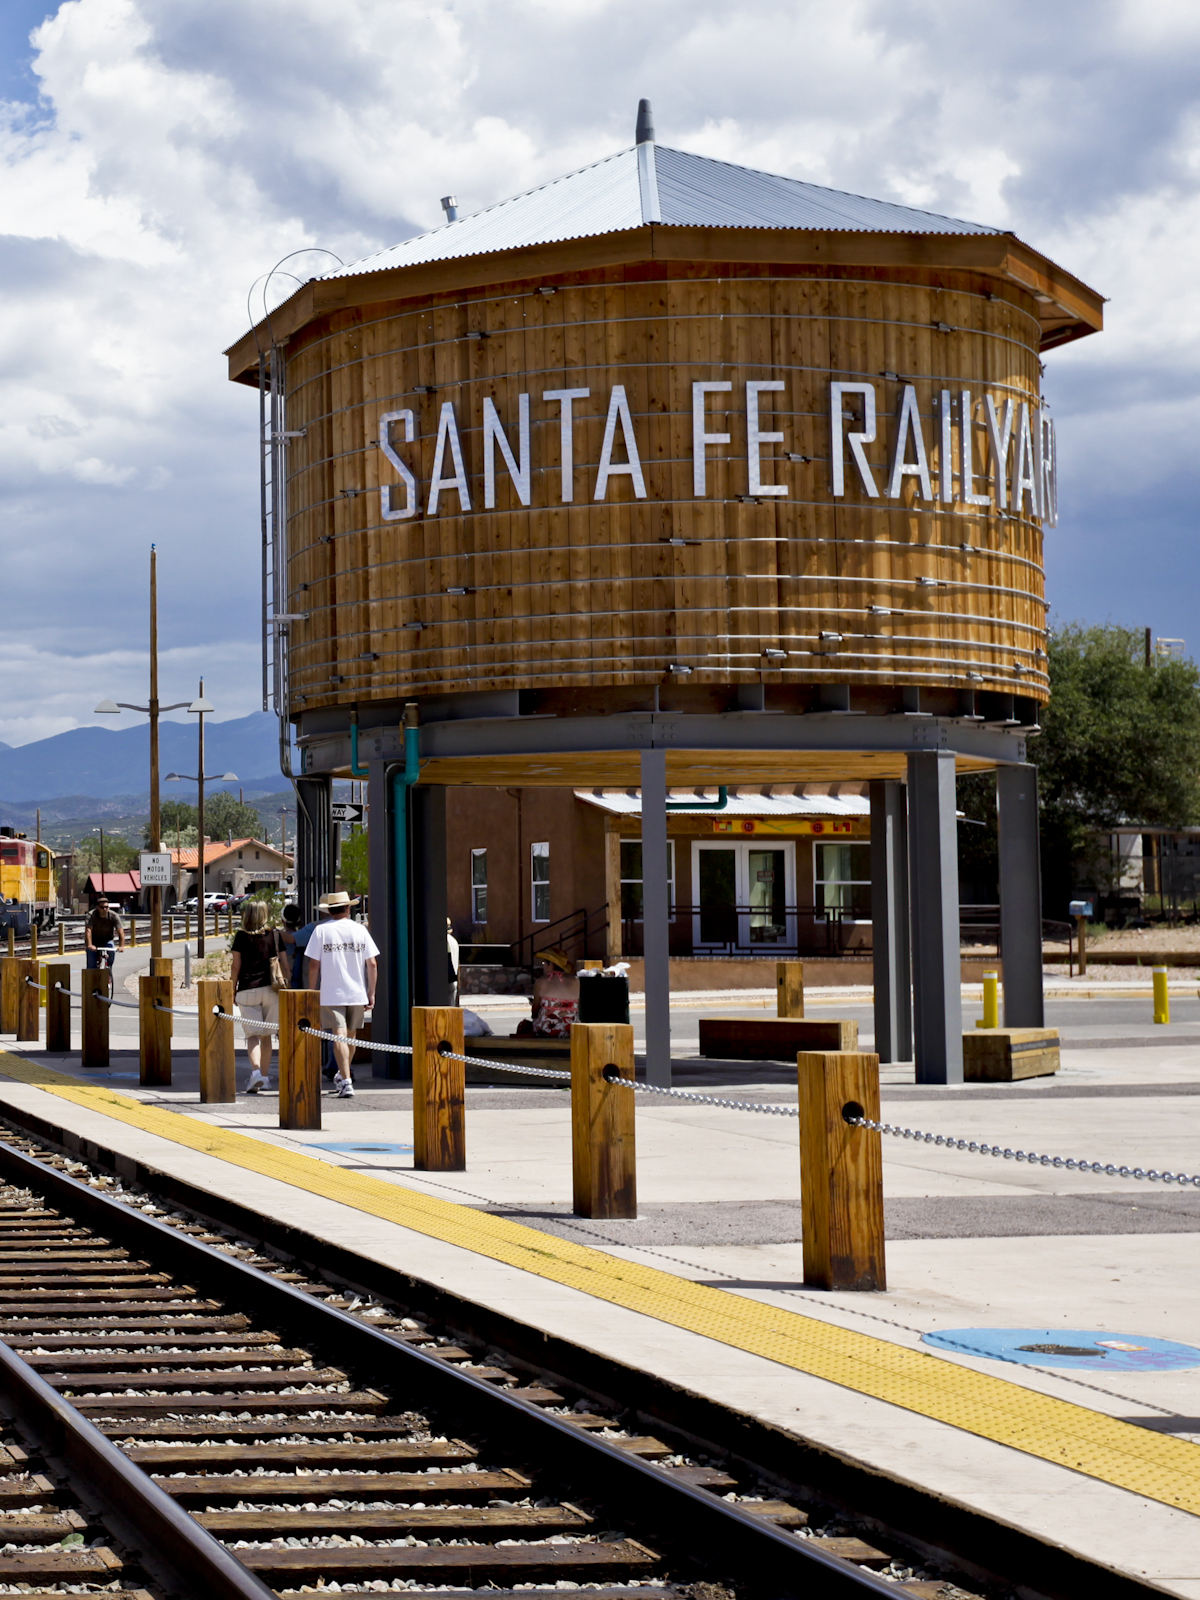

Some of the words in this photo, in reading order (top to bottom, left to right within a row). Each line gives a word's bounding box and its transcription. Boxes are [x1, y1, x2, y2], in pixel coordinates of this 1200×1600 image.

[379, 384, 648, 521] SANTA
[692, 380, 789, 496] FE
[143, 874, 168, 882] VEHICLES
